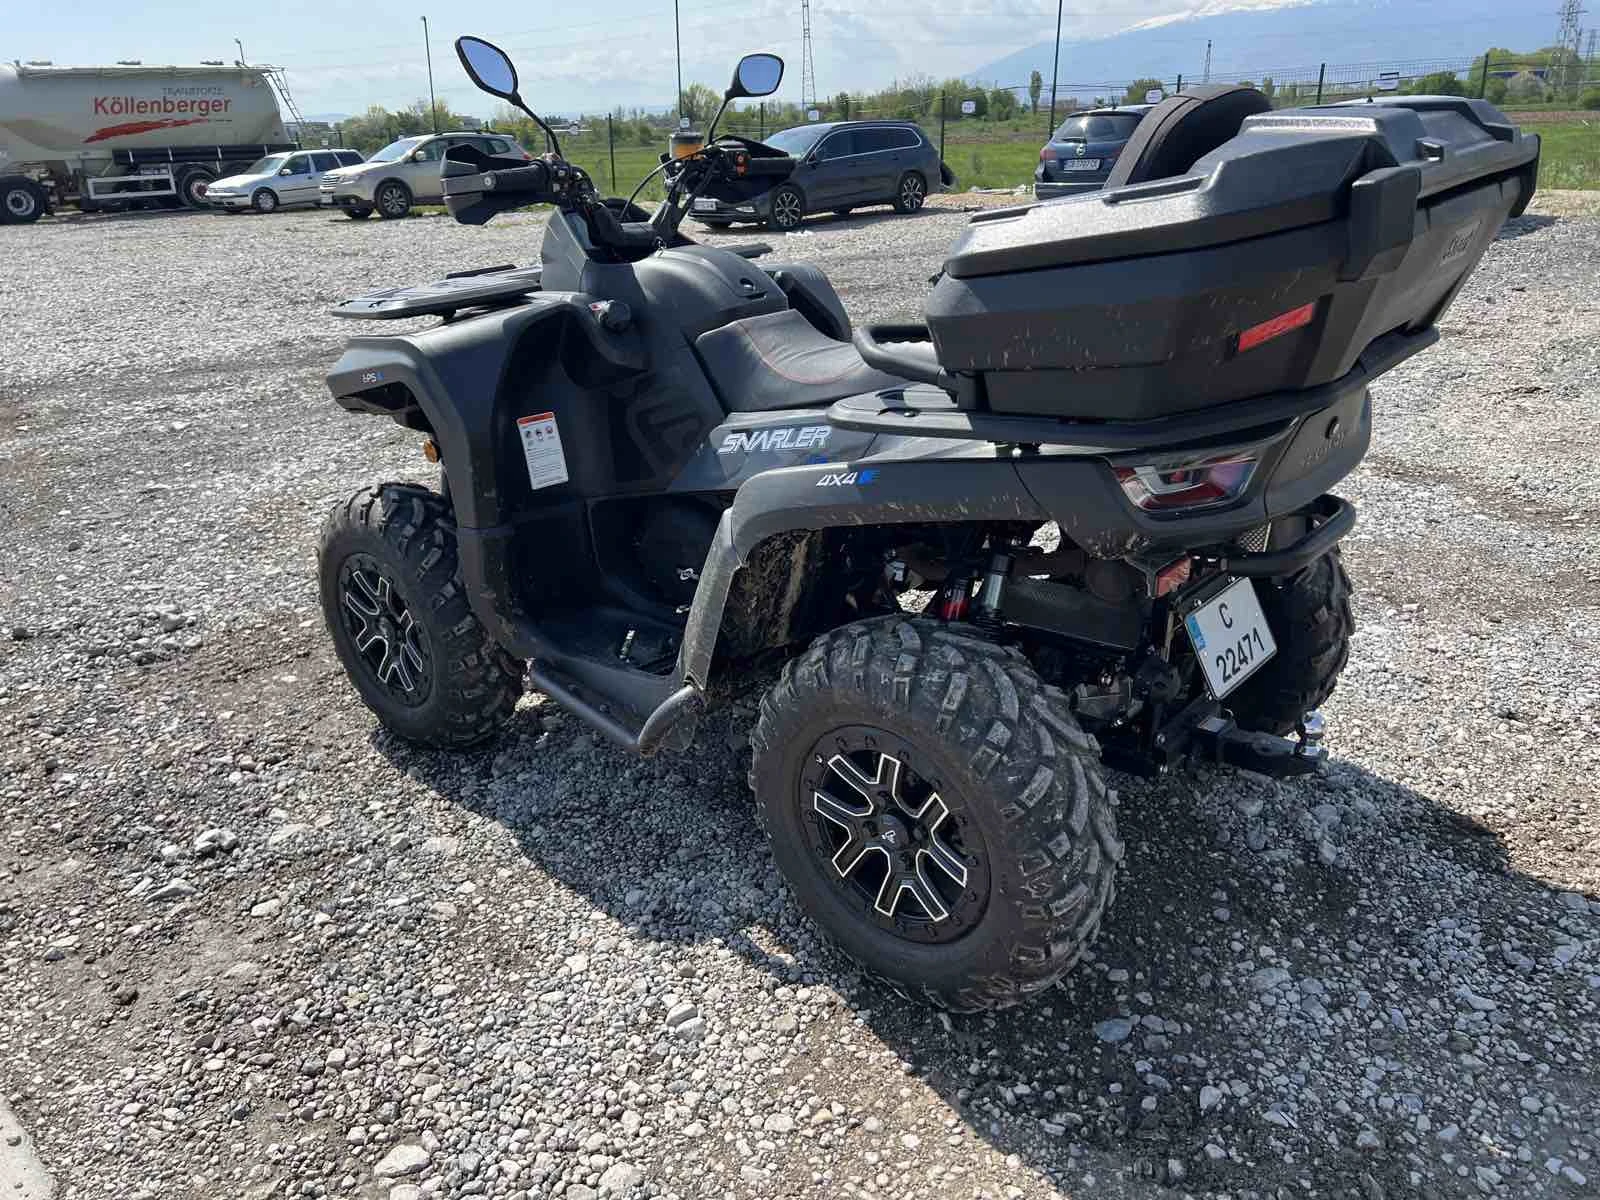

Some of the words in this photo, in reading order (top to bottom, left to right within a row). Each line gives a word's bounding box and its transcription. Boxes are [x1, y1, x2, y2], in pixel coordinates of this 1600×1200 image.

[93, 95, 232, 116] Köllenberger
[717, 425, 832, 455] SNARLER
[1217, 602, 1233, 629] C
[1215, 626, 1265, 683] 22471
